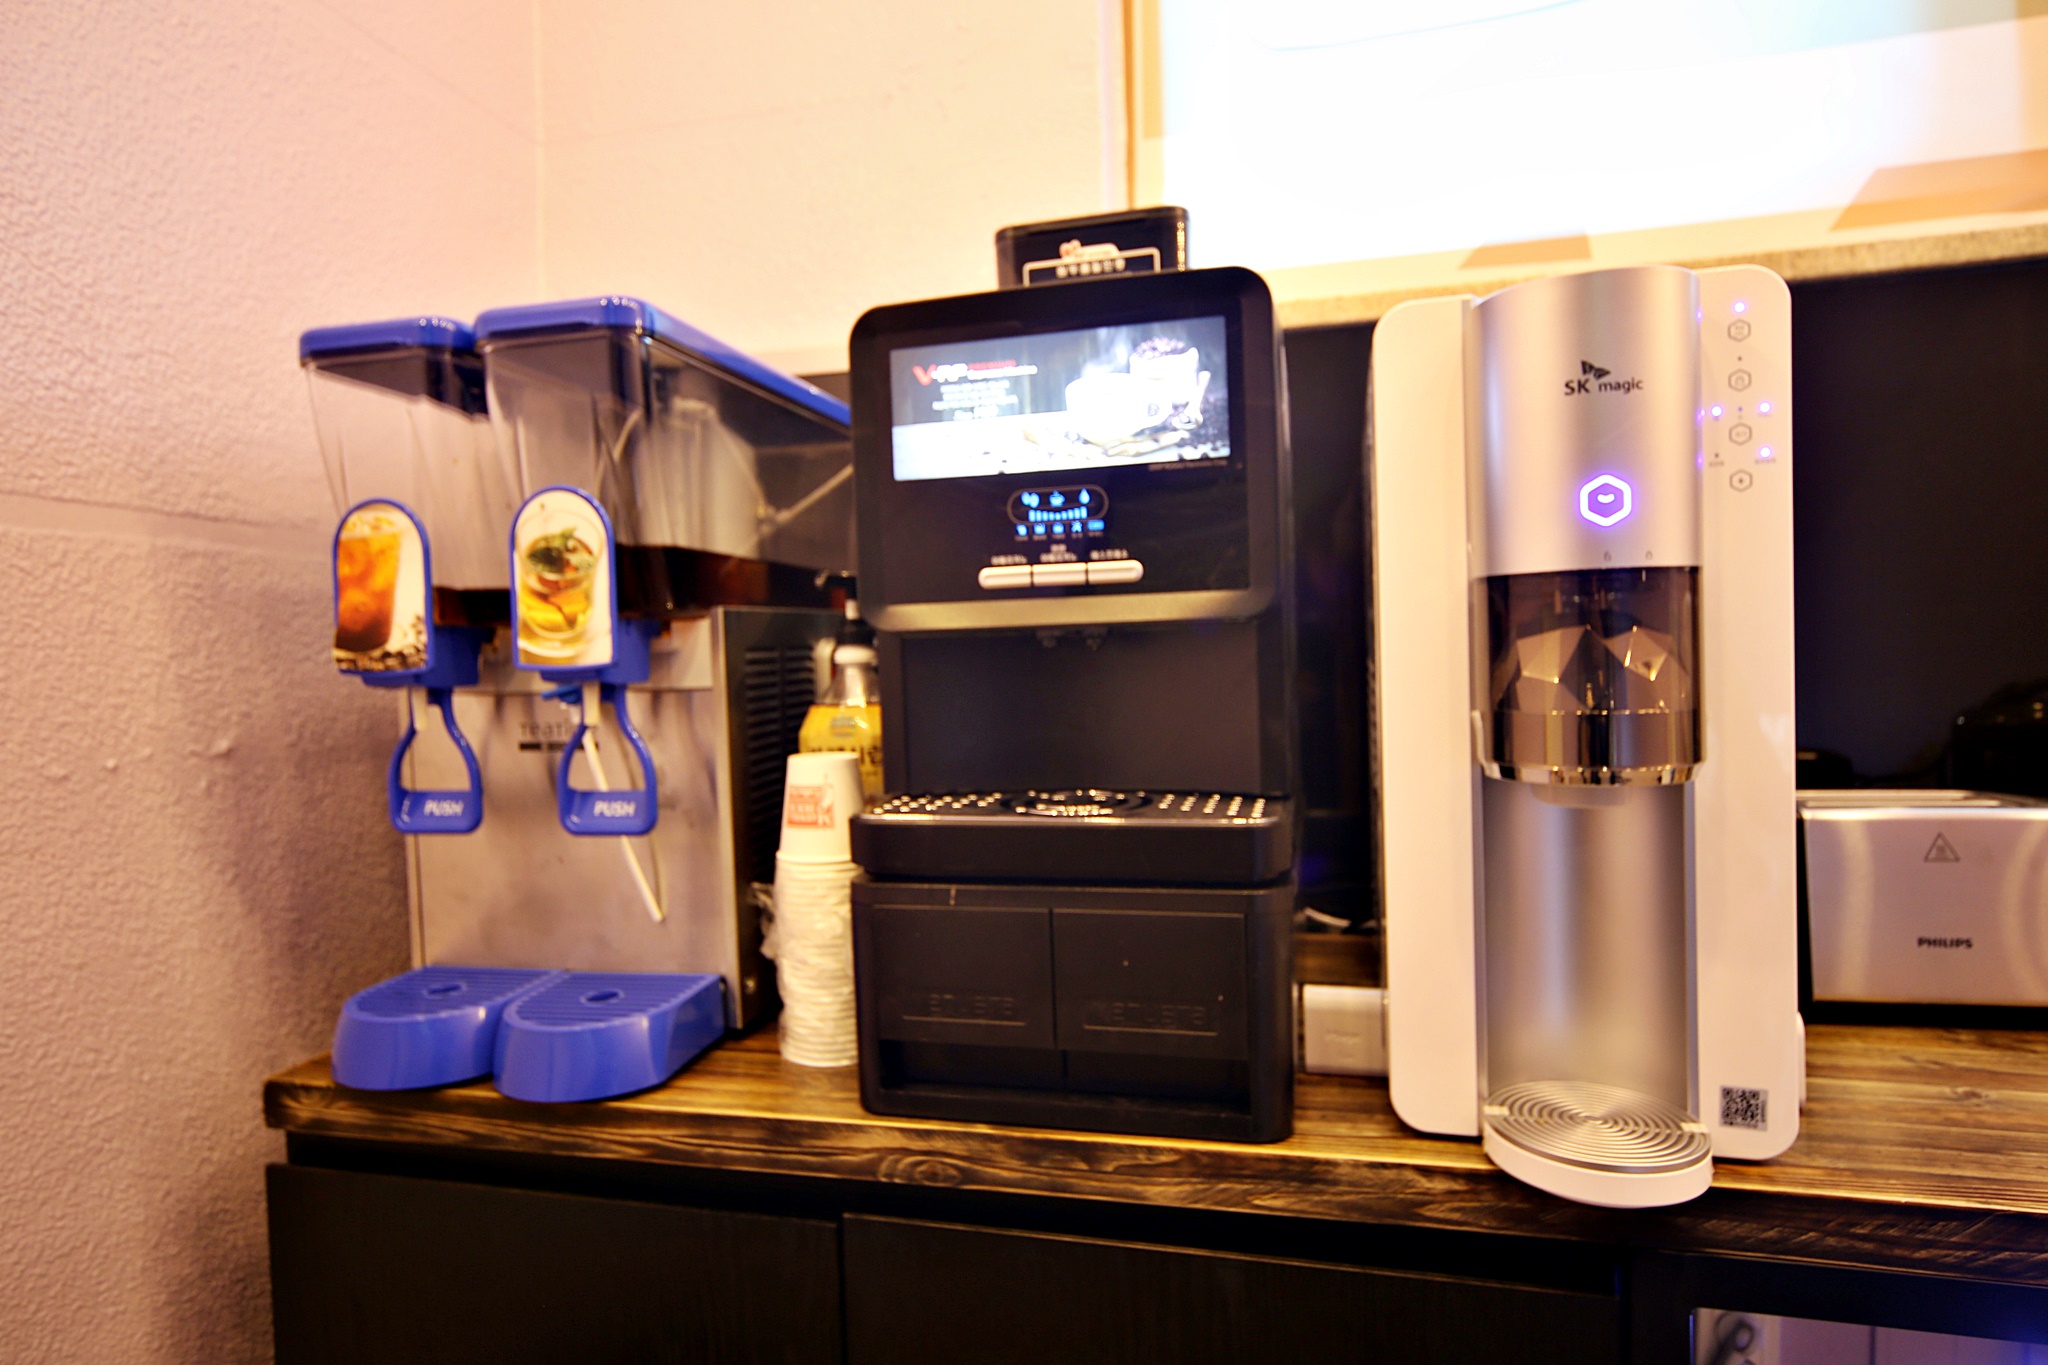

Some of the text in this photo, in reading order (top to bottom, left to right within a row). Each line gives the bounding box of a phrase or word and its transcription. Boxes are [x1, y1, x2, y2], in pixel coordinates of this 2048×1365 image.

[1564, 377, 1643, 395] SK magic
[423, 799, 465, 817] PUSH
[593, 799, 636, 817] PUSH
[1917, 936, 1973, 949] PHILIPS
